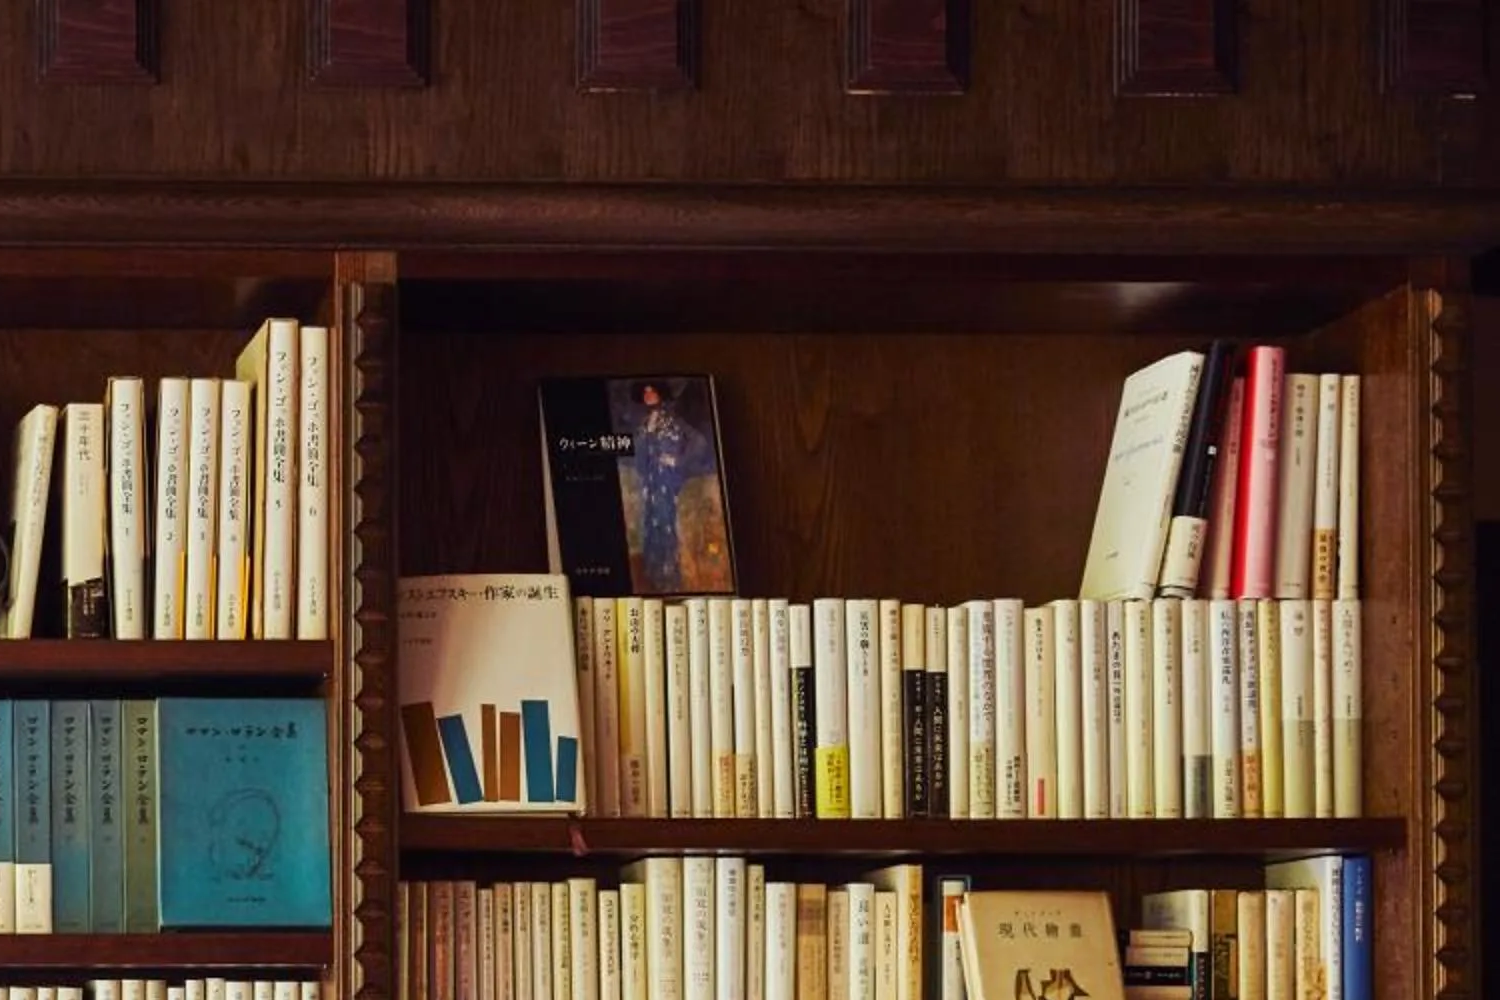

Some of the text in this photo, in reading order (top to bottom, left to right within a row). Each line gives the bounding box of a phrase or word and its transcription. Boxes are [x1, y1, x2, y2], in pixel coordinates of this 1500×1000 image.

[558, 435, 633, 450] ウィーン精神
